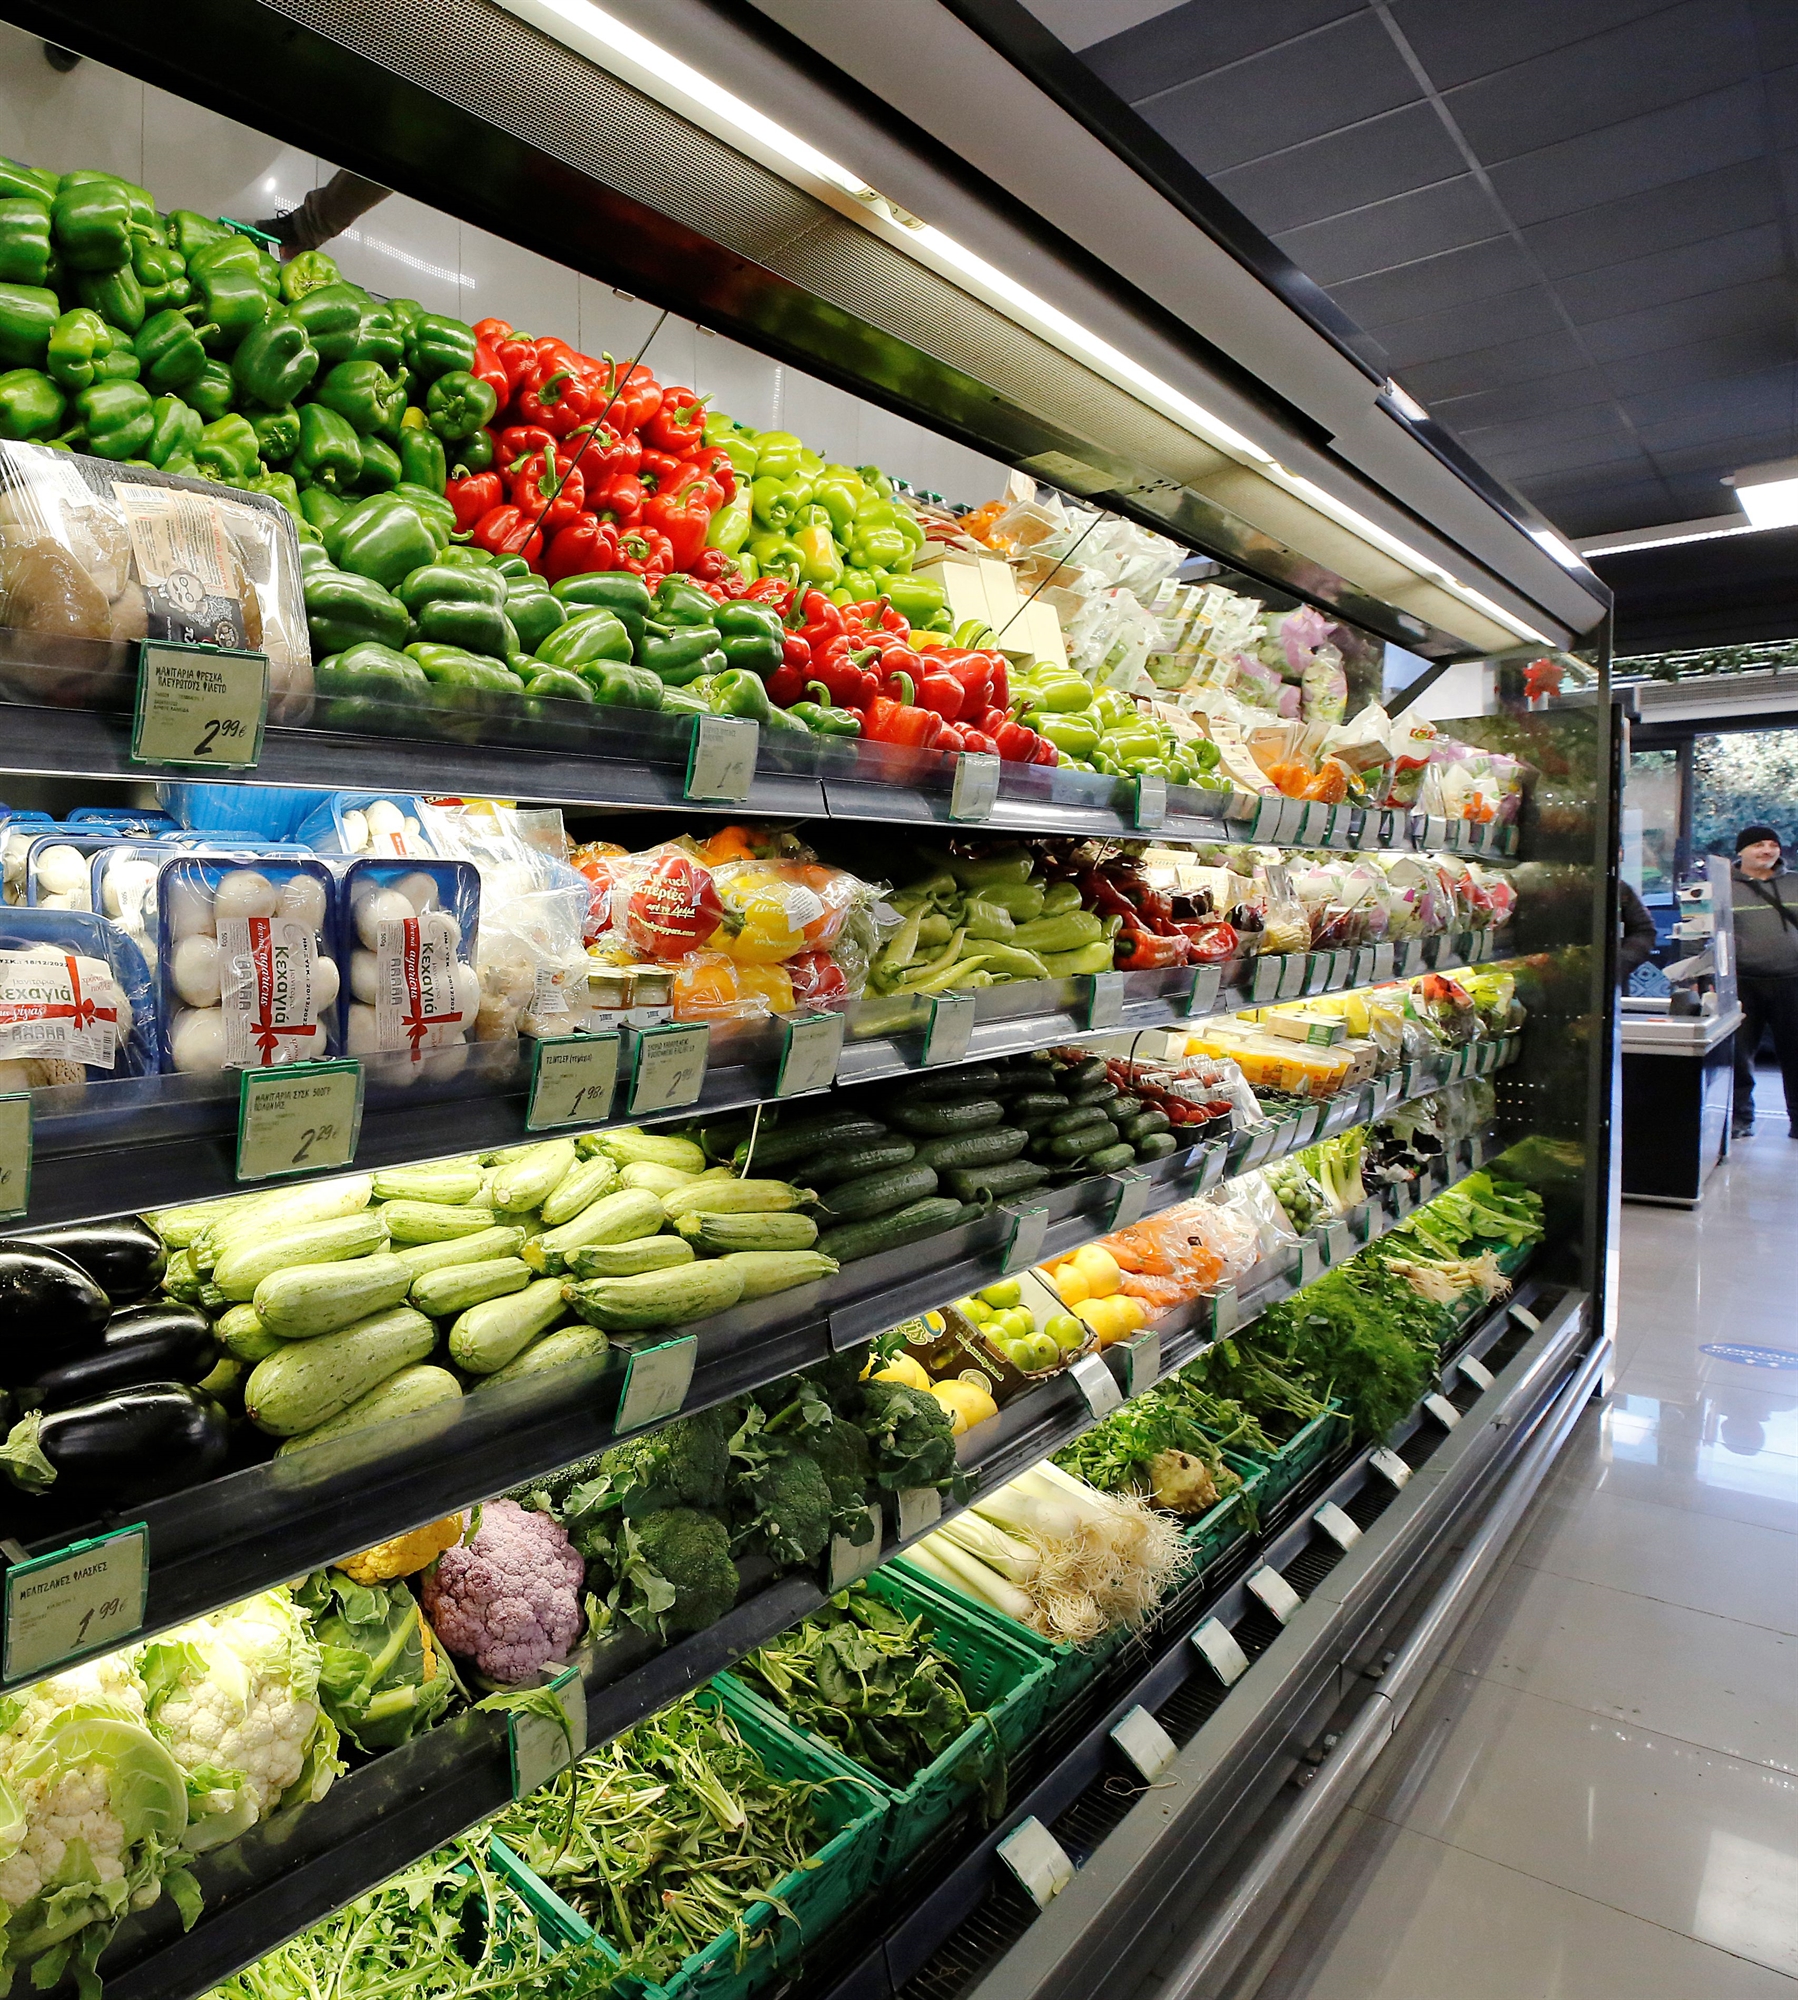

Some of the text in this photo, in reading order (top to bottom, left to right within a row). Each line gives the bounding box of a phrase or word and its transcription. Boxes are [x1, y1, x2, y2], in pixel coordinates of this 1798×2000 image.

[155, 666, 223, 683] ΜΑΝΙΤΑΡΙΑ ΦΡΕΣΚΑ
[158, 675, 227, 693] ΠΛΕΥΡΩΤΟΥΣ ΦΙΛΕΤΟ
[255, 952, 272, 1008] agaricus
[273, 946, 290, 1024] Κεχαγιά
[404, 949, 418, 1000] agaricus
[421, 942, 438, 1014] Κεχαγιά
[20, 1561, 108, 1601] ΜΕΛΙΤΖΑΝΕΣ ΦΛΑΣΚΕΣ
